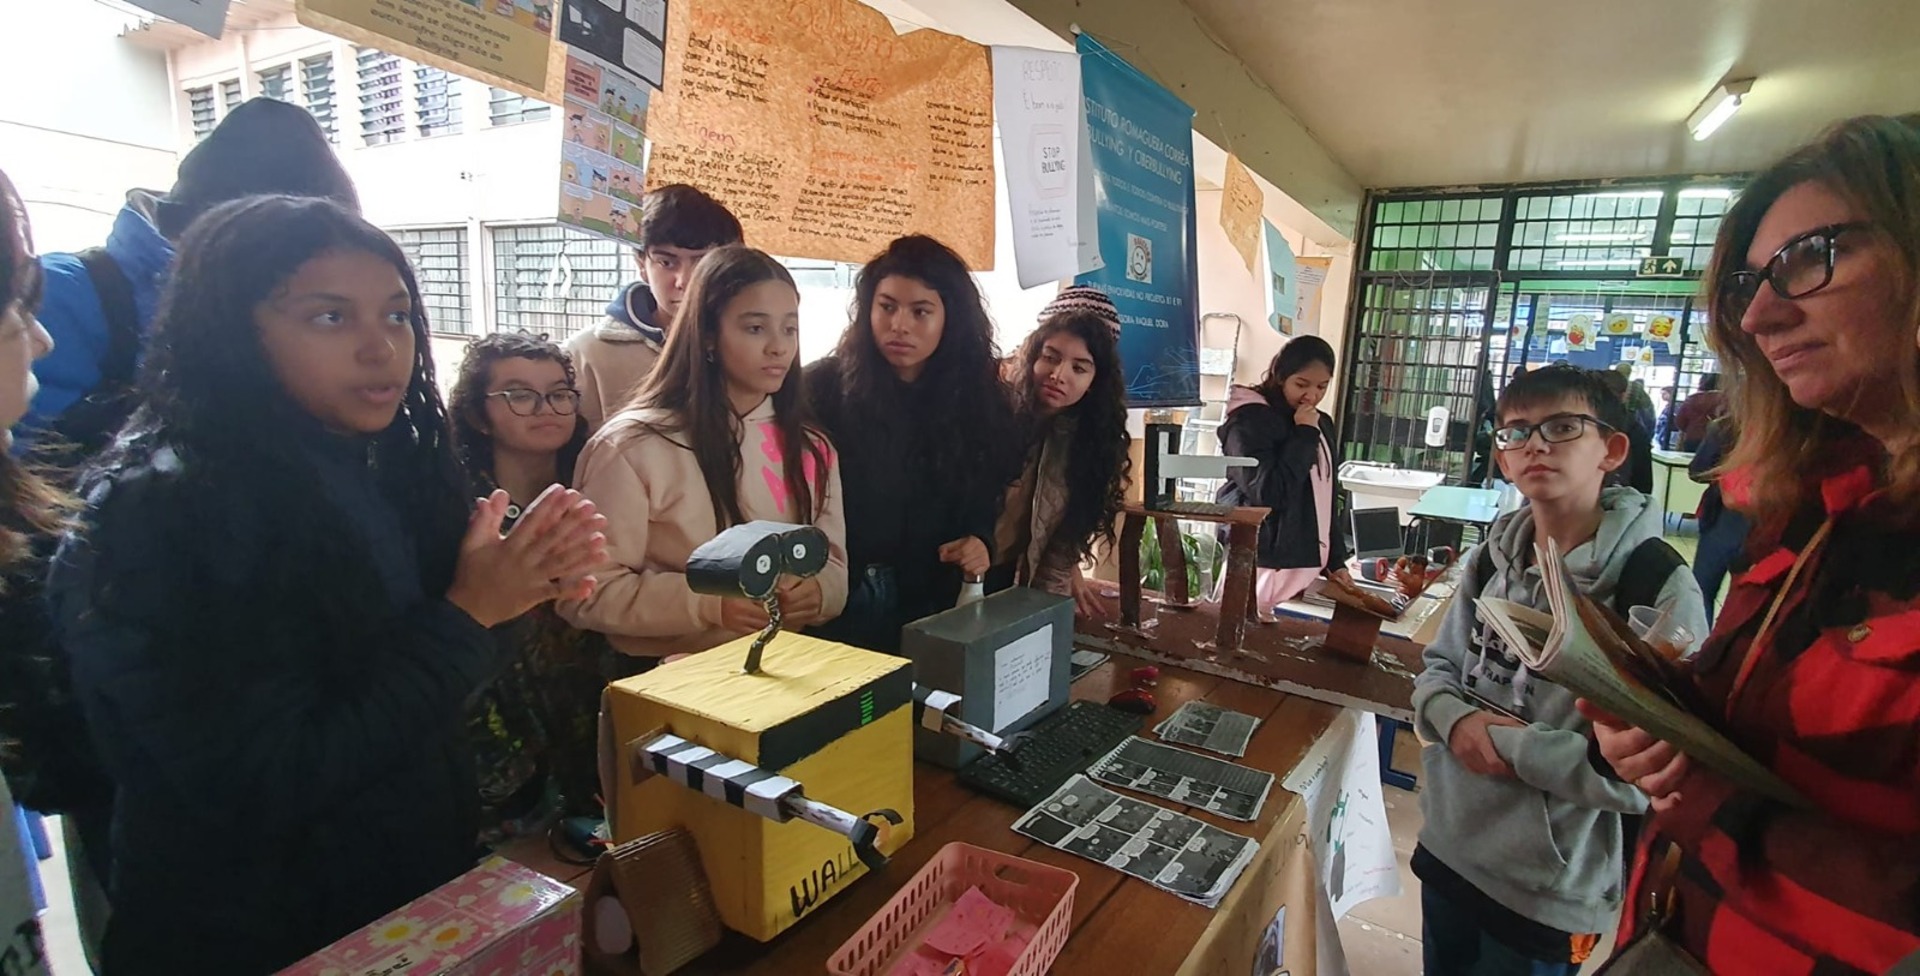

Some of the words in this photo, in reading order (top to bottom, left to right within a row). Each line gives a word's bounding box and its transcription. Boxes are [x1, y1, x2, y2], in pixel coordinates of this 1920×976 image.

[398, 4, 424, 21] lado
[370, 8, 404, 26] outro
[442, 32, 467, 49] Diga
[468, 43, 488, 57] não
[474, 22, 511, 42] apenas
[1085, 97, 1119, 128] STITUTO
[1043, 146, 1060, 159] STOP
[1041, 159, 1066, 174] BULLYING
